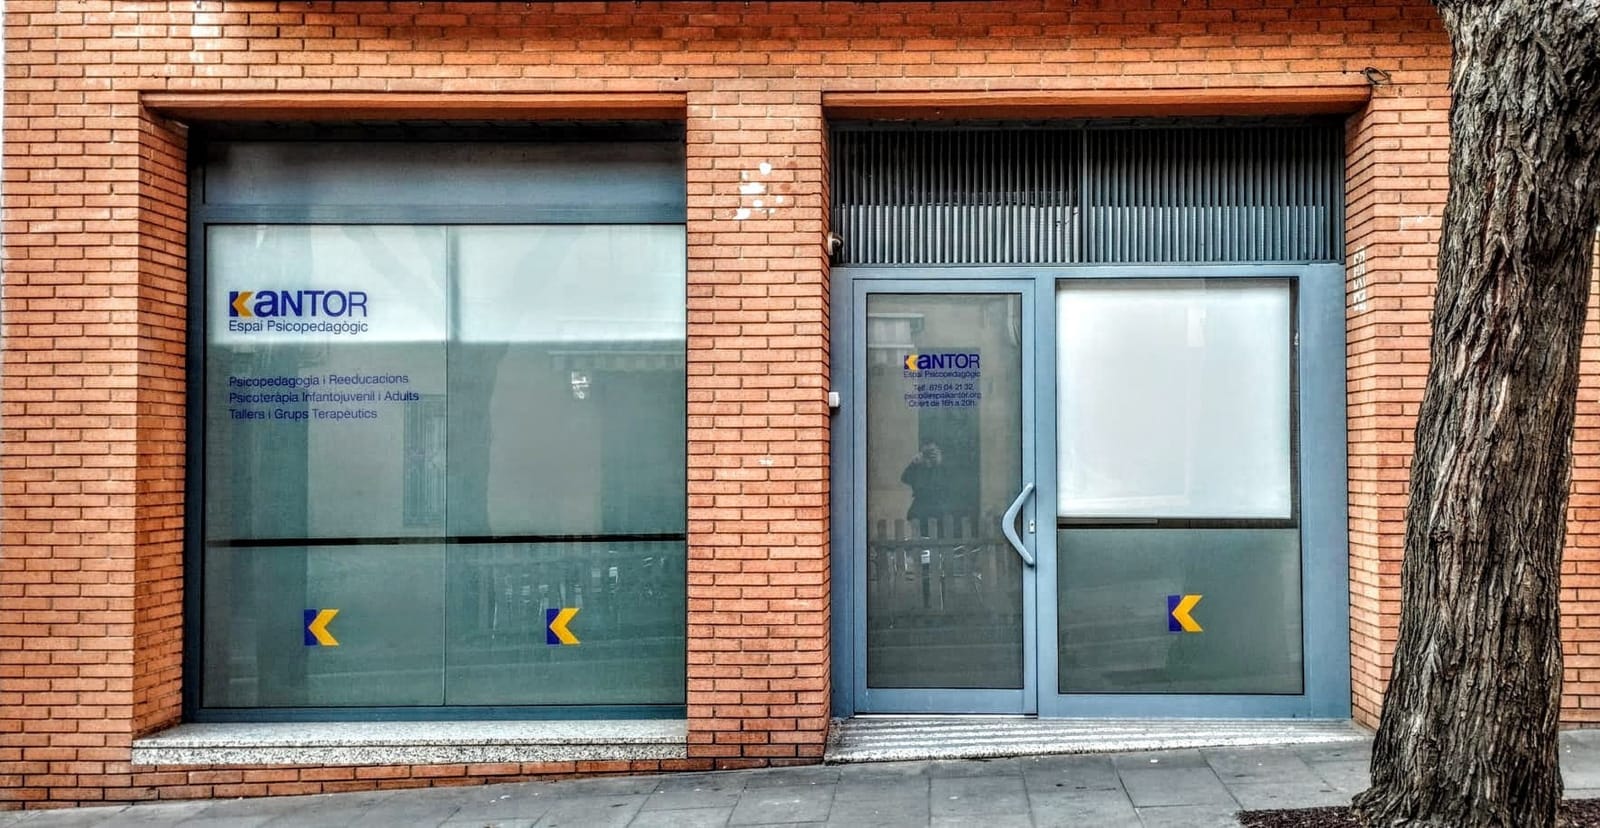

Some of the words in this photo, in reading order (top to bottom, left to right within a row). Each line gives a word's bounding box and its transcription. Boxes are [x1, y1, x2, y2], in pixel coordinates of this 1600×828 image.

[229, 320, 263, 334] Espai
[267, 320, 368, 334] Psicopedagògic
[229, 376, 320, 388] Psicopedagogia
[329, 373, 409, 385] Reeducacions
[302, 391, 375, 404] Infantojuvenil
[384, 391, 420, 401] Adults
[229, 409, 265, 419] Tallers
[274, 409, 309, 422] Grups
